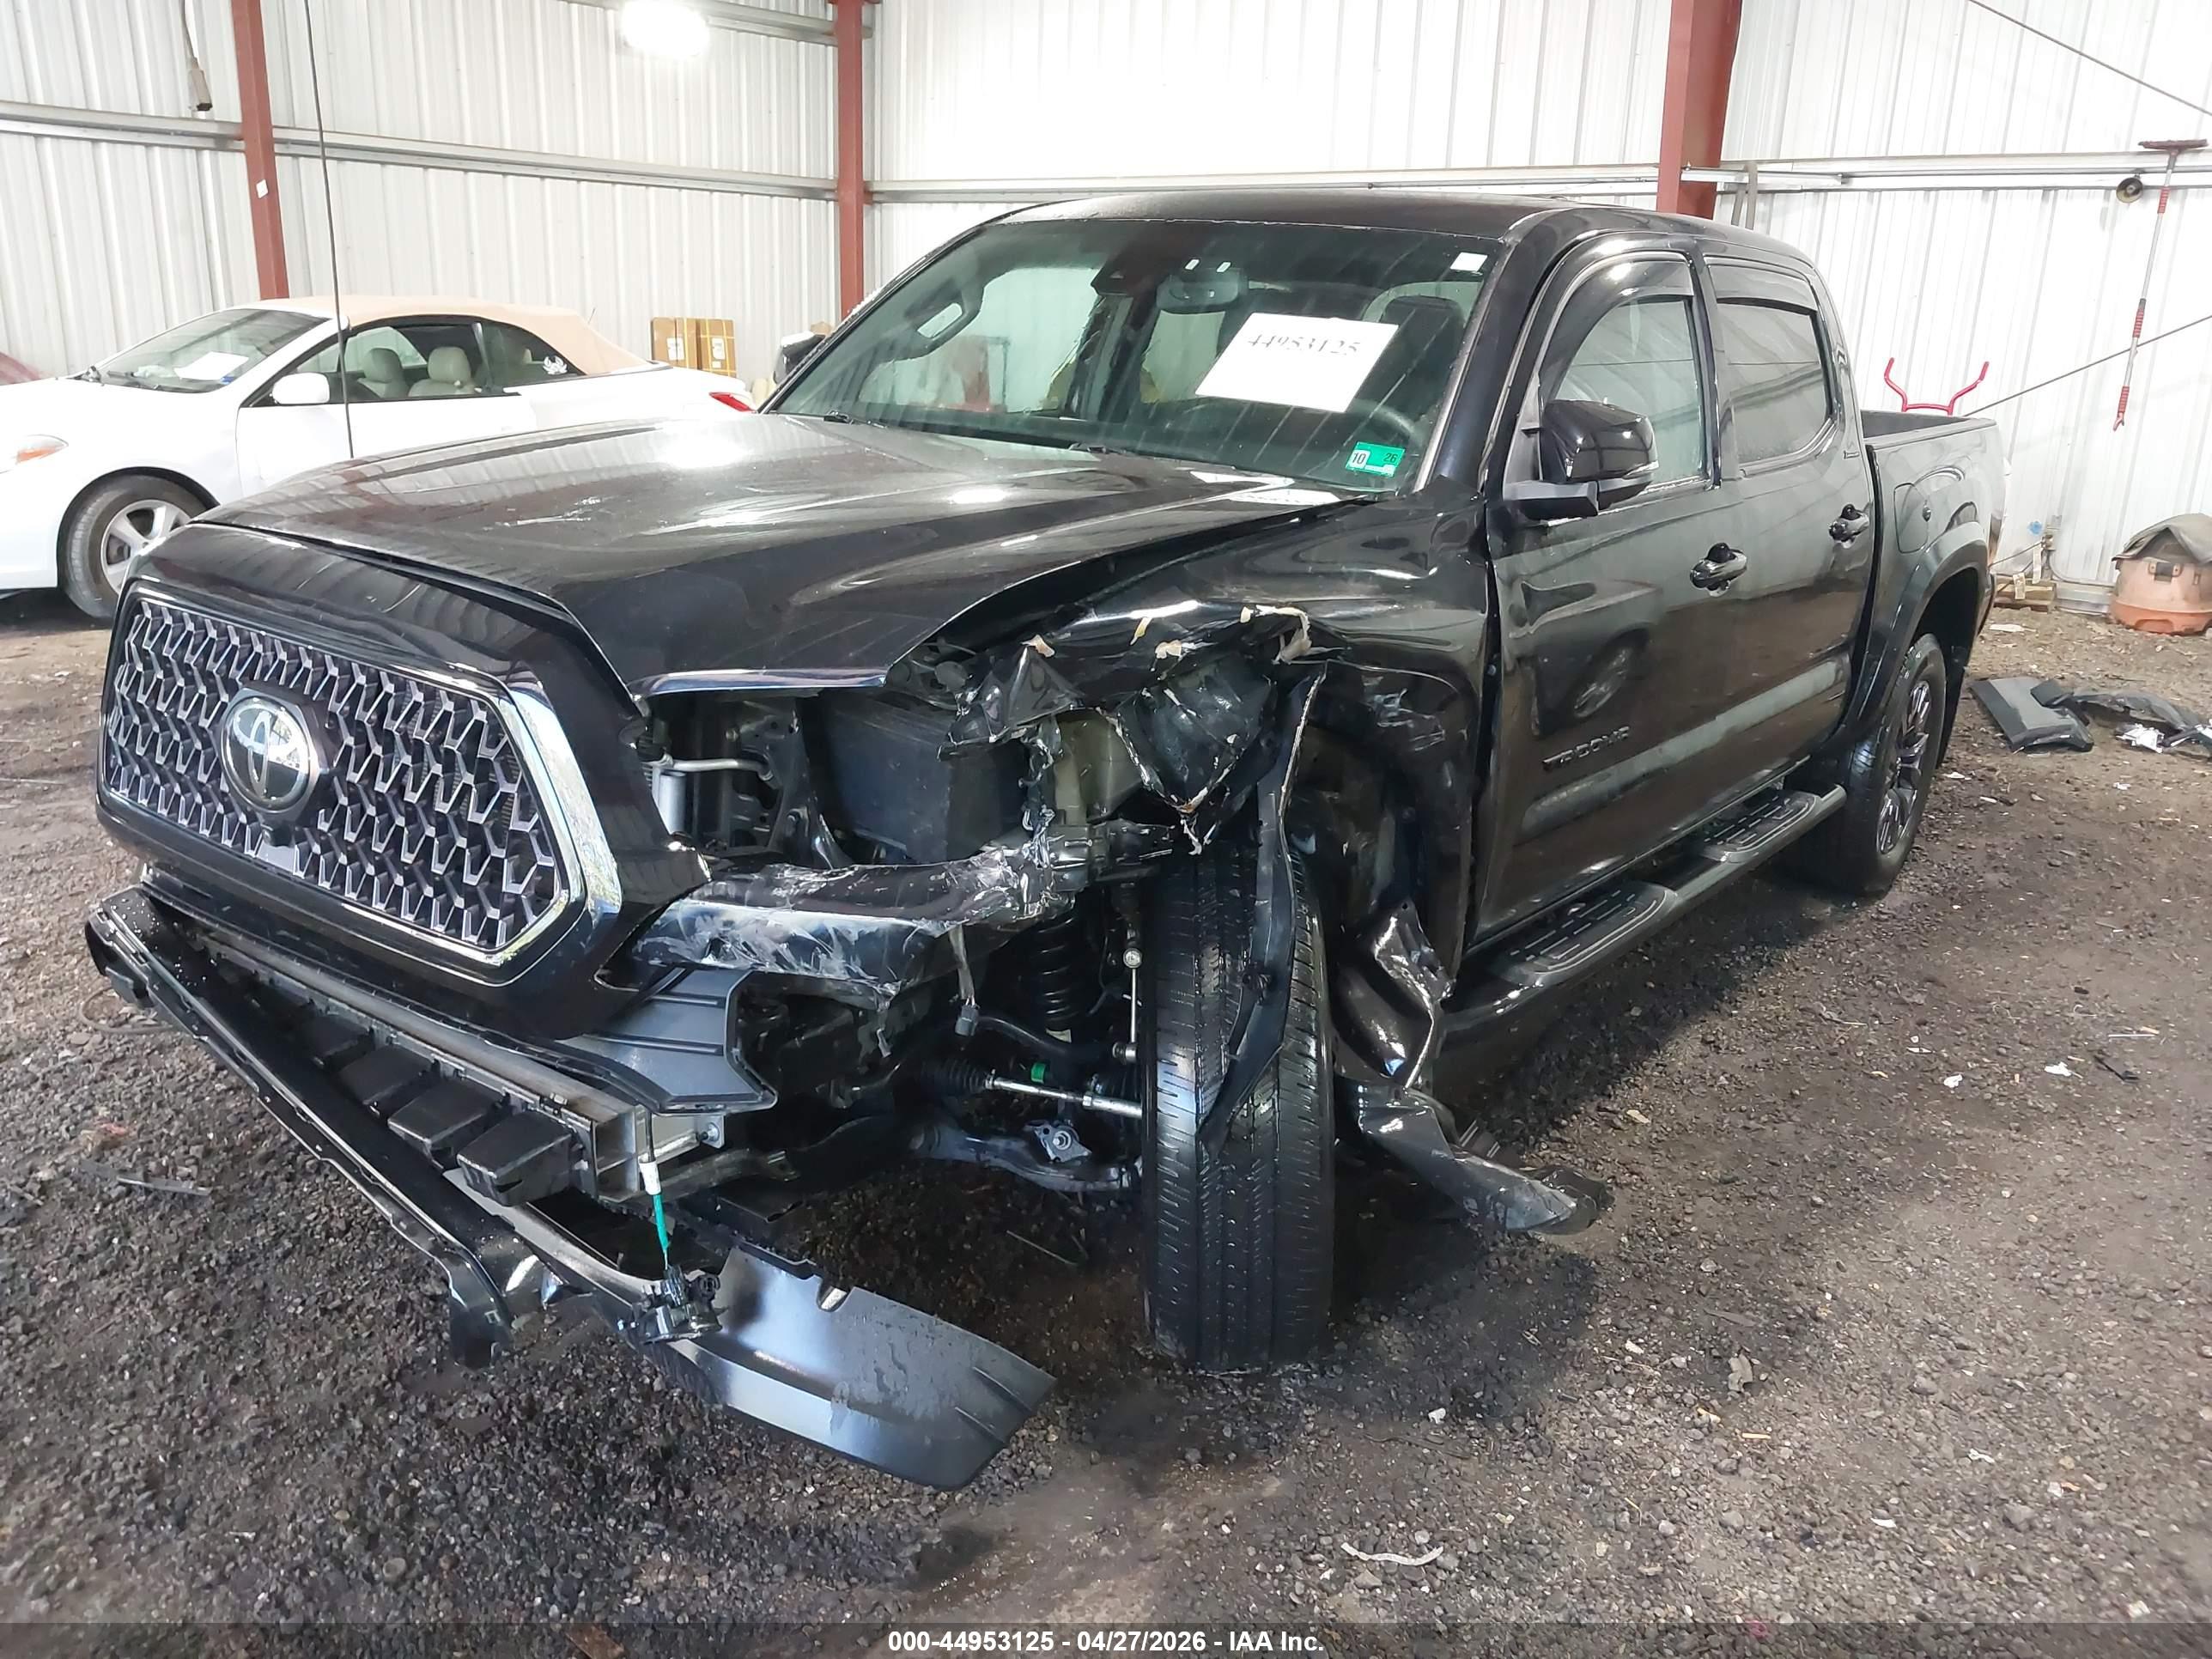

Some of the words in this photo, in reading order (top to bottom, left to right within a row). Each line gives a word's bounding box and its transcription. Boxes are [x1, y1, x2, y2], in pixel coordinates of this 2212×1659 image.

[1247, 334, 1361, 356] 44953125
[1352, 452, 1367, 465] 10
[1383, 452, 1399, 464] 26
